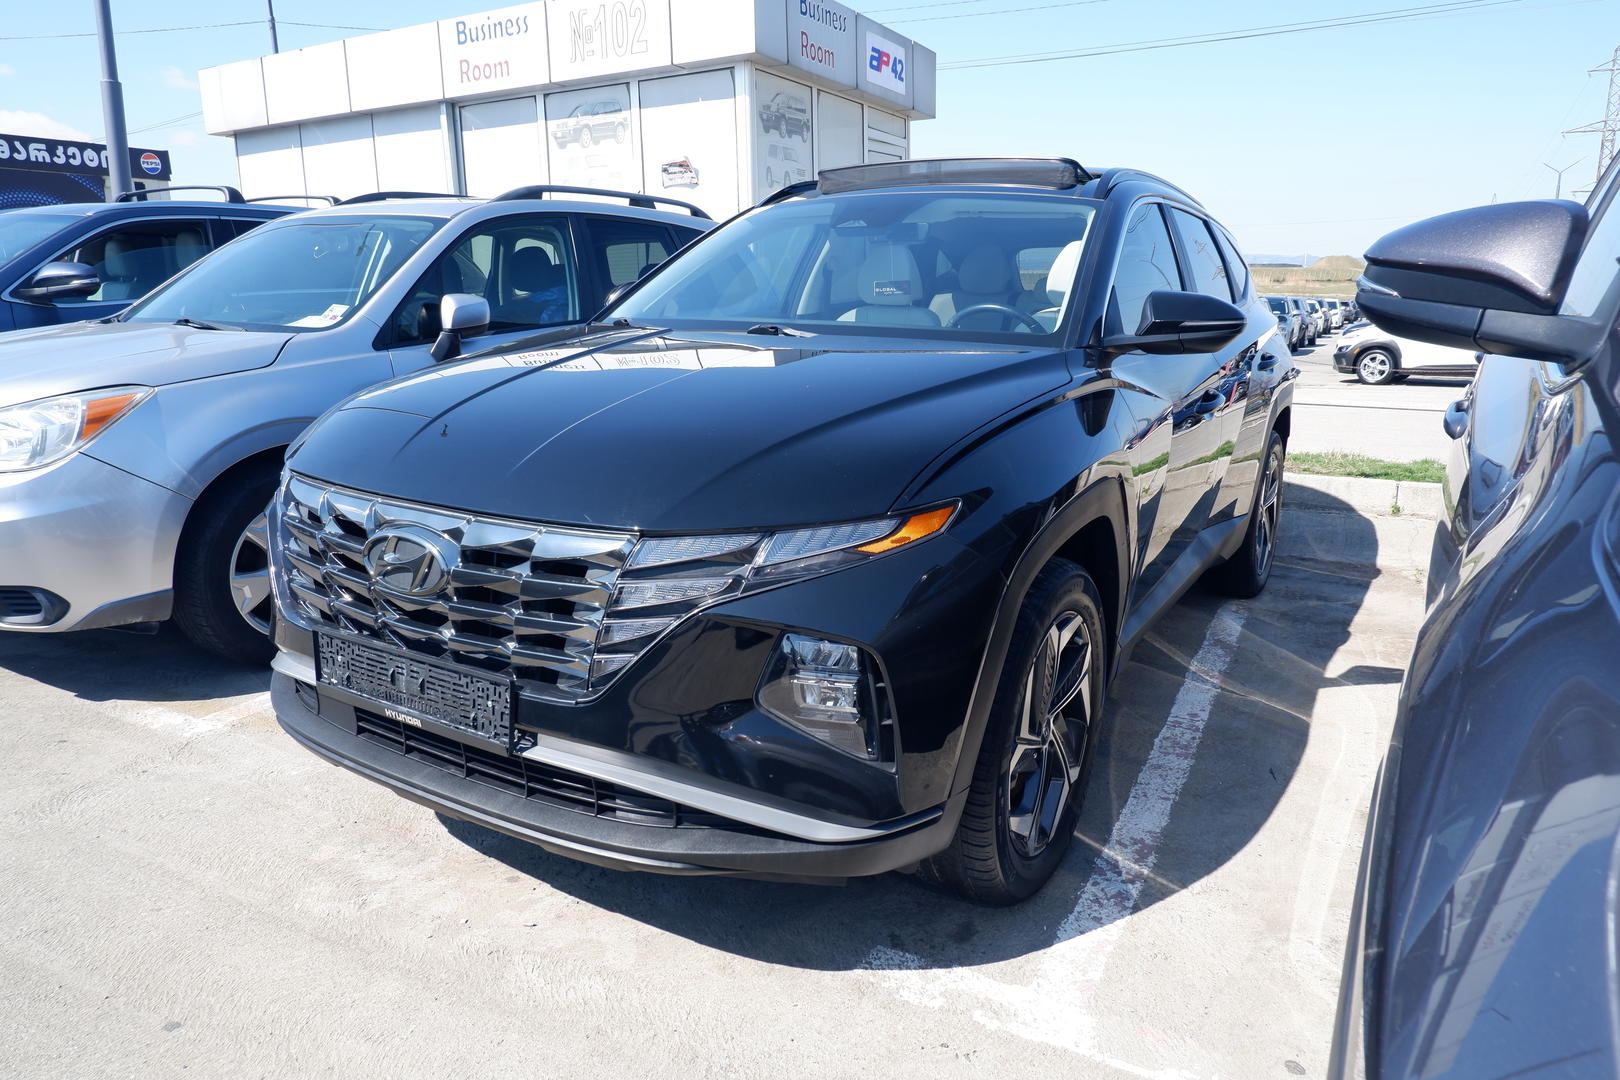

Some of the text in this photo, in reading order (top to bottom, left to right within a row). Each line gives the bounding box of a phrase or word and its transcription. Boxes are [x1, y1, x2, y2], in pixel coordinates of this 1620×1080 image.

[800, 0, 846, 32] Business
[456, 15, 529, 45] Business
[801, 31, 835, 68] Room
[459, 59, 510, 83] Room
[891, 57, 904, 82] 42
[385, 708, 421, 727] HYUNDAI
